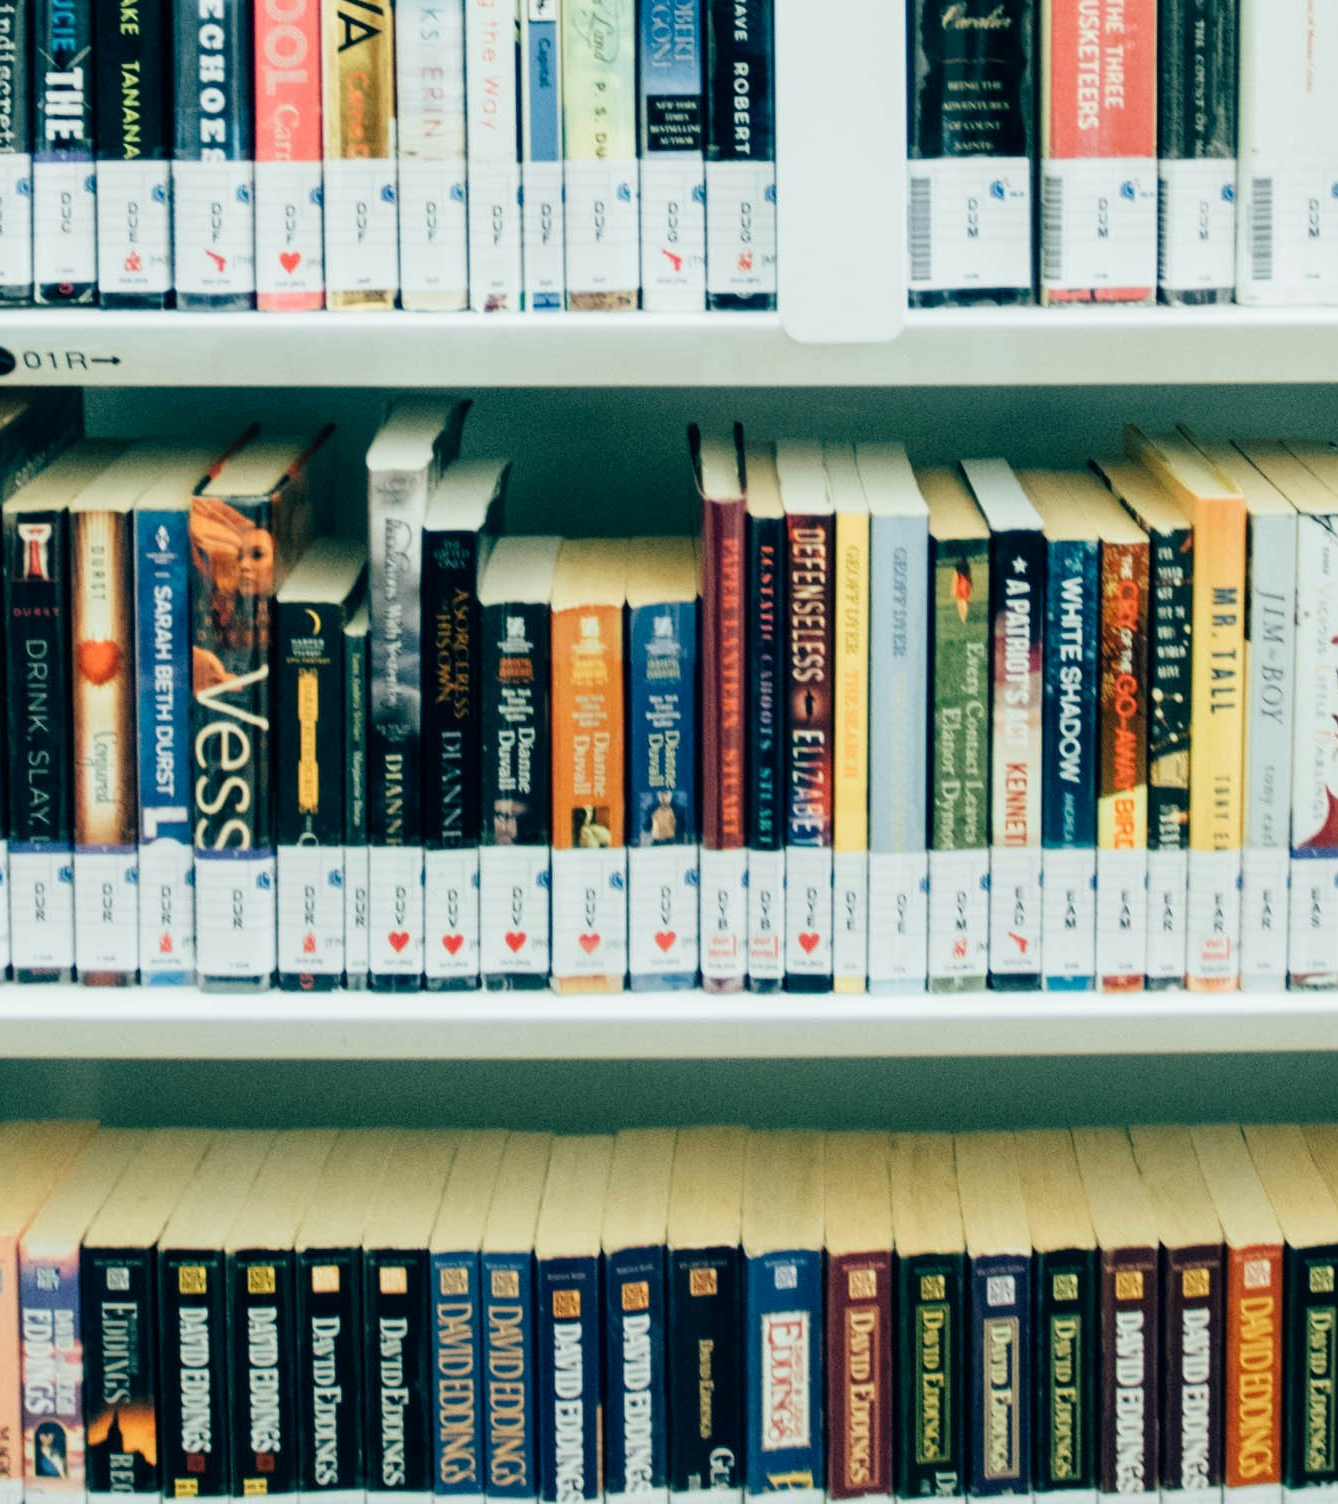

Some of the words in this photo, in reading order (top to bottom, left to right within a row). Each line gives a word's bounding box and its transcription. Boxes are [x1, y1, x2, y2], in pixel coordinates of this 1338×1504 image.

[733, 61, 750, 155] ROBERT
[1105, 45, 1126, 109] THREE
[967, 197, 979, 239] DUM
[21, 349, 89, 371] 01R
[790, 526, 826, 683] DEFENSELESS
[1059, 575, 1082, 663] WHITE
[1005, 599, 1032, 706] PATRIOT'S
[1209, 650, 1235, 714] TALL
[152, 664, 173, 721] BETH
[1058, 664, 1082, 784] SHADOW
[153, 725, 175, 796] DURST
[310, 1315, 342, 1384] DAVID
[1240, 1296, 1274, 1371] DAVID
[312, 1387, 342, 1487] EDDINGS
[1237, 1371, 1274, 1478] EDDINGS
